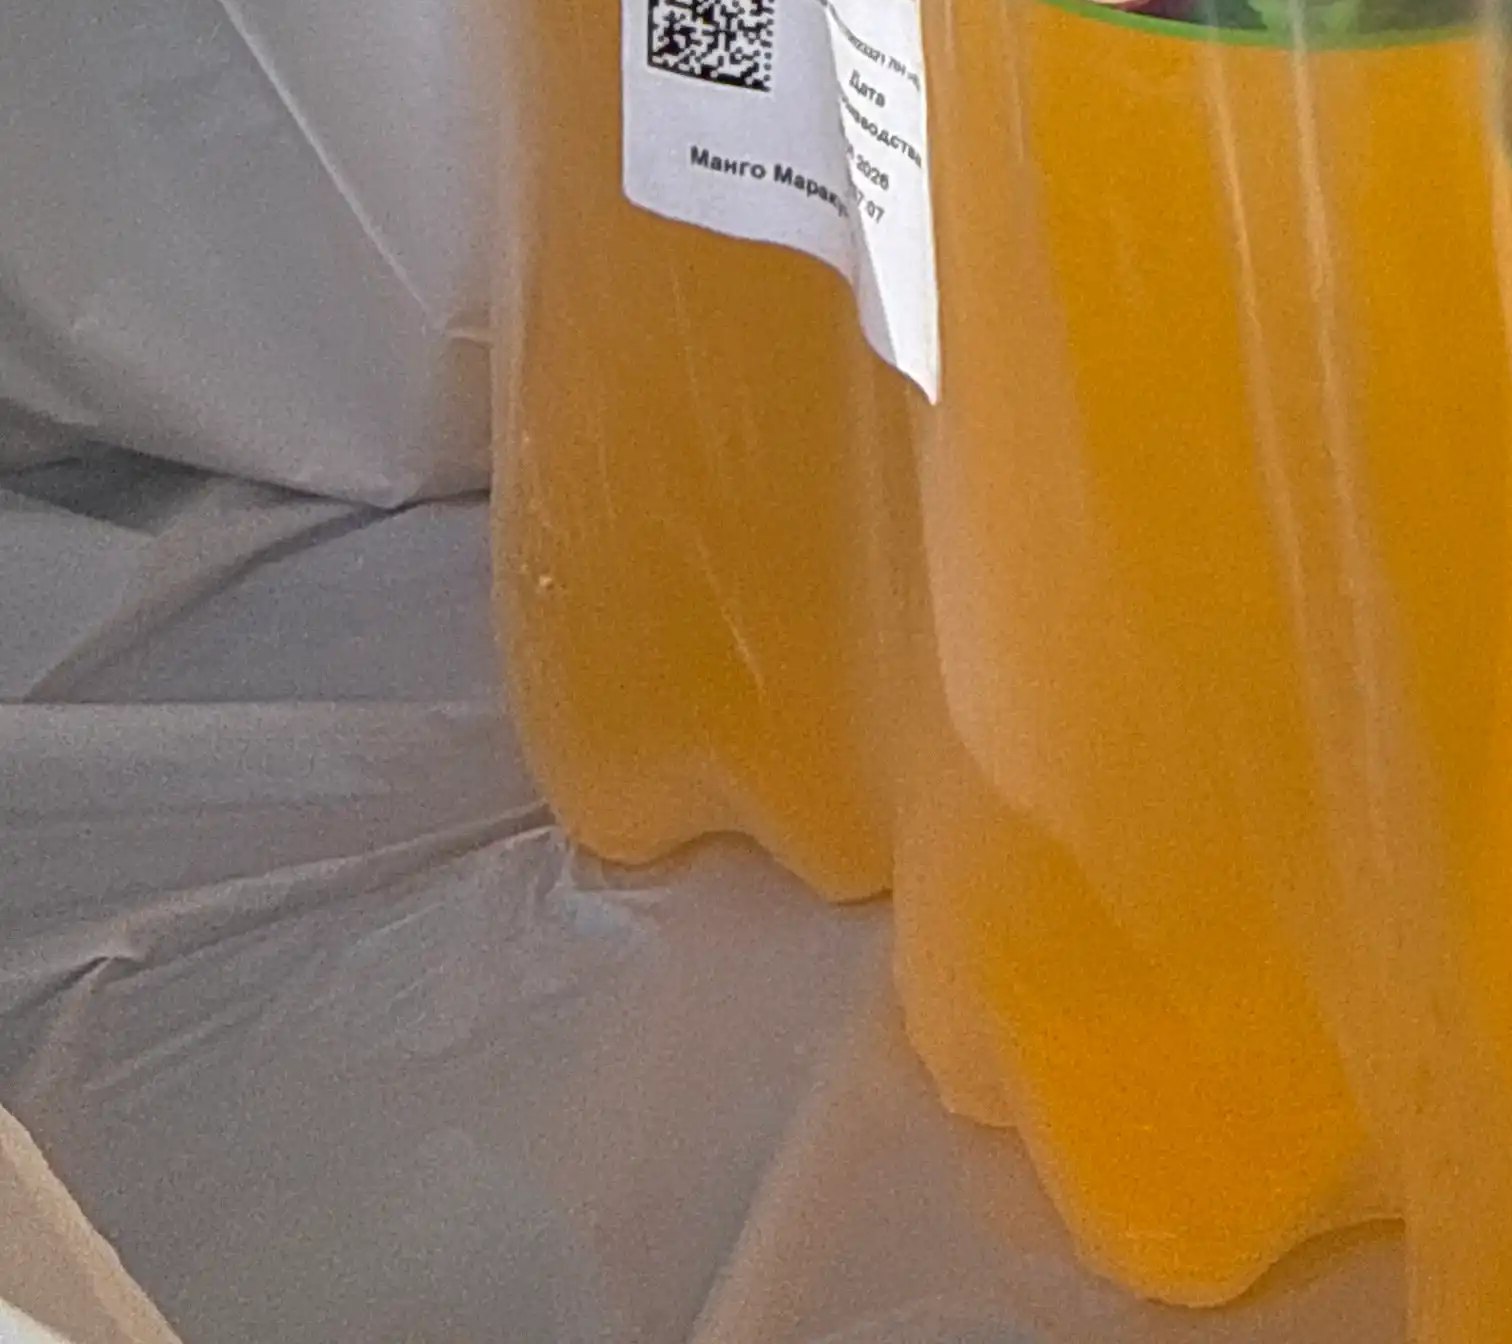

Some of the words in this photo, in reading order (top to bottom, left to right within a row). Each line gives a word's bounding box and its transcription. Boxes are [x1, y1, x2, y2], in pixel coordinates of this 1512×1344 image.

[849, 69, 886, 108] Дата
[690, 145, 767, 180] Манго
[856, 153, 890, 191] 2026
[866, 199, 886, 224] 07
